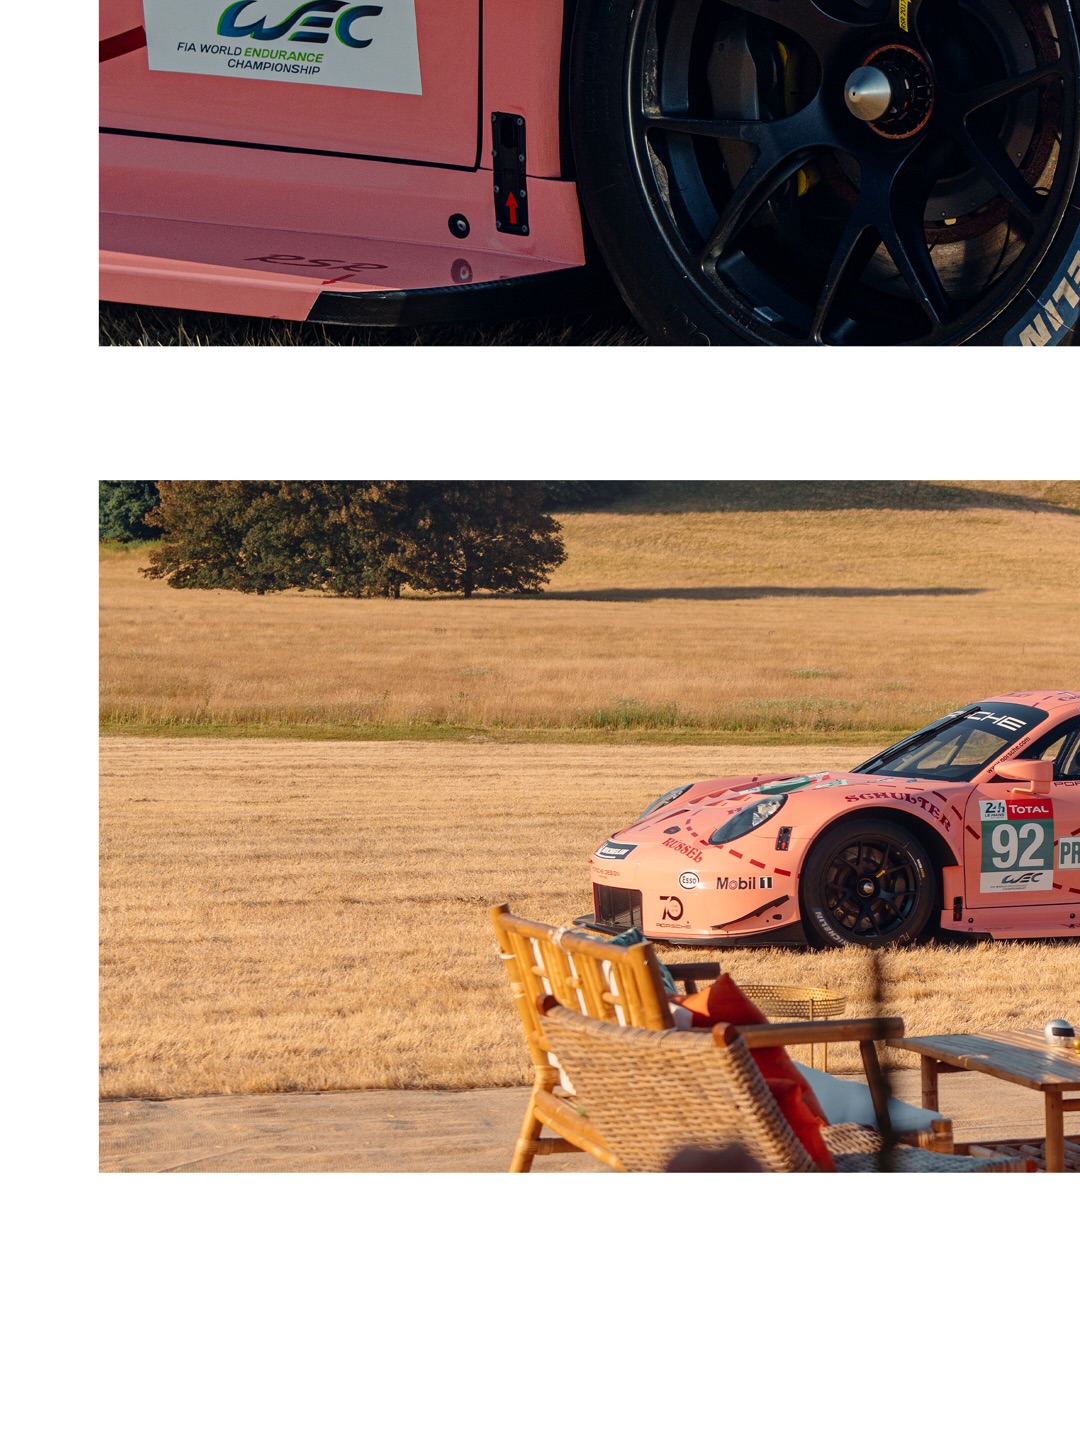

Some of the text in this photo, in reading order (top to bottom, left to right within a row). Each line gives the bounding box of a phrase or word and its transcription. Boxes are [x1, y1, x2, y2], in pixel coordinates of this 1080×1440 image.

[177, 42, 324, 63] FIA WORLD ENDURANCE
[227, 58, 321, 75] CHAMPIONSHIP
[845, 792, 952, 832] SCHULTER
[985, 802, 1005, 814] 24h
[1009, 804, 1049, 814] TOTAL
[662, 837, 703, 863] RÜSSEL
[992, 823, 1044, 869] 92
[716, 877, 756, 890] Mobil
[660, 896, 684, 921] 70
